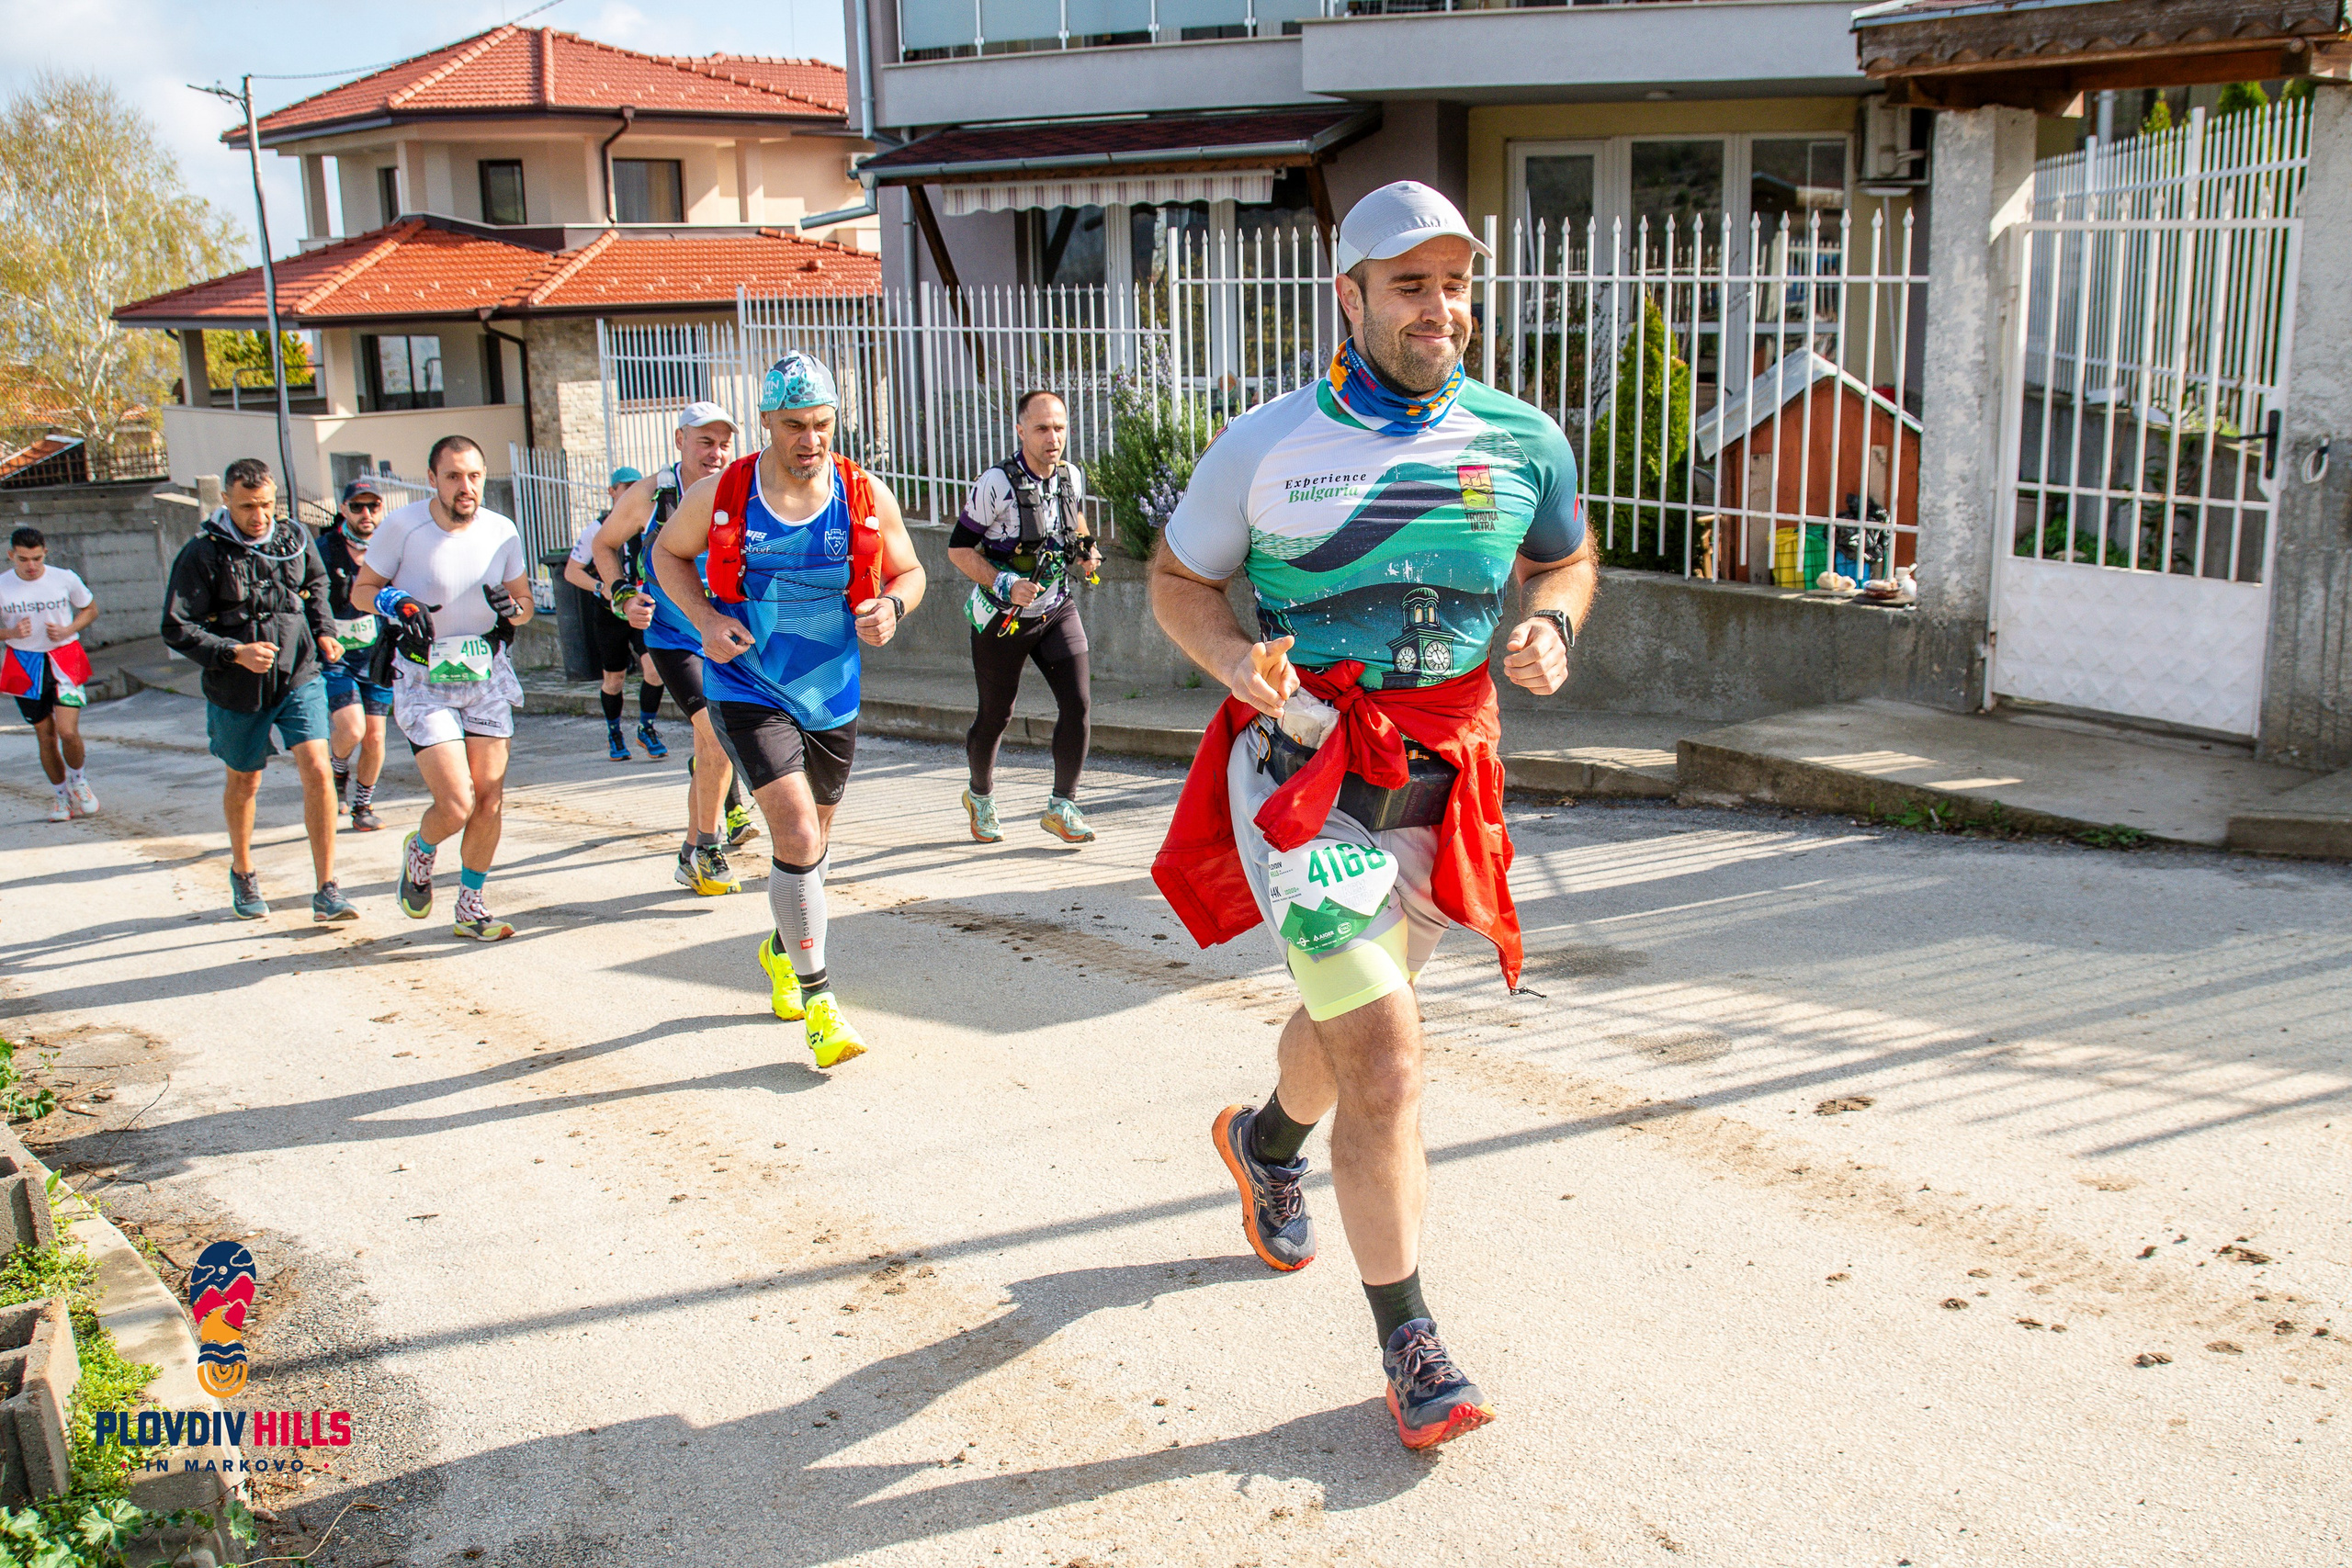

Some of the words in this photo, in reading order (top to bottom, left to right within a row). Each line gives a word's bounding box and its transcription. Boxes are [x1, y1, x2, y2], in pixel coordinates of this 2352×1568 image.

[1284, 473, 1367, 490] Experience
[1288, 483, 1359, 504] Bulgaria
[1464, 511, 1499, 522] TRYAVNA
[1470, 521, 1496, 532] ULTRA
[4, 597, 66, 614] uhlsport
[350, 618, 373, 634] 4157
[460, 638, 489, 658] 4115
[1307, 842, 1387, 888] 4168
[798, 879, 810, 937] COMPRESSPORT
